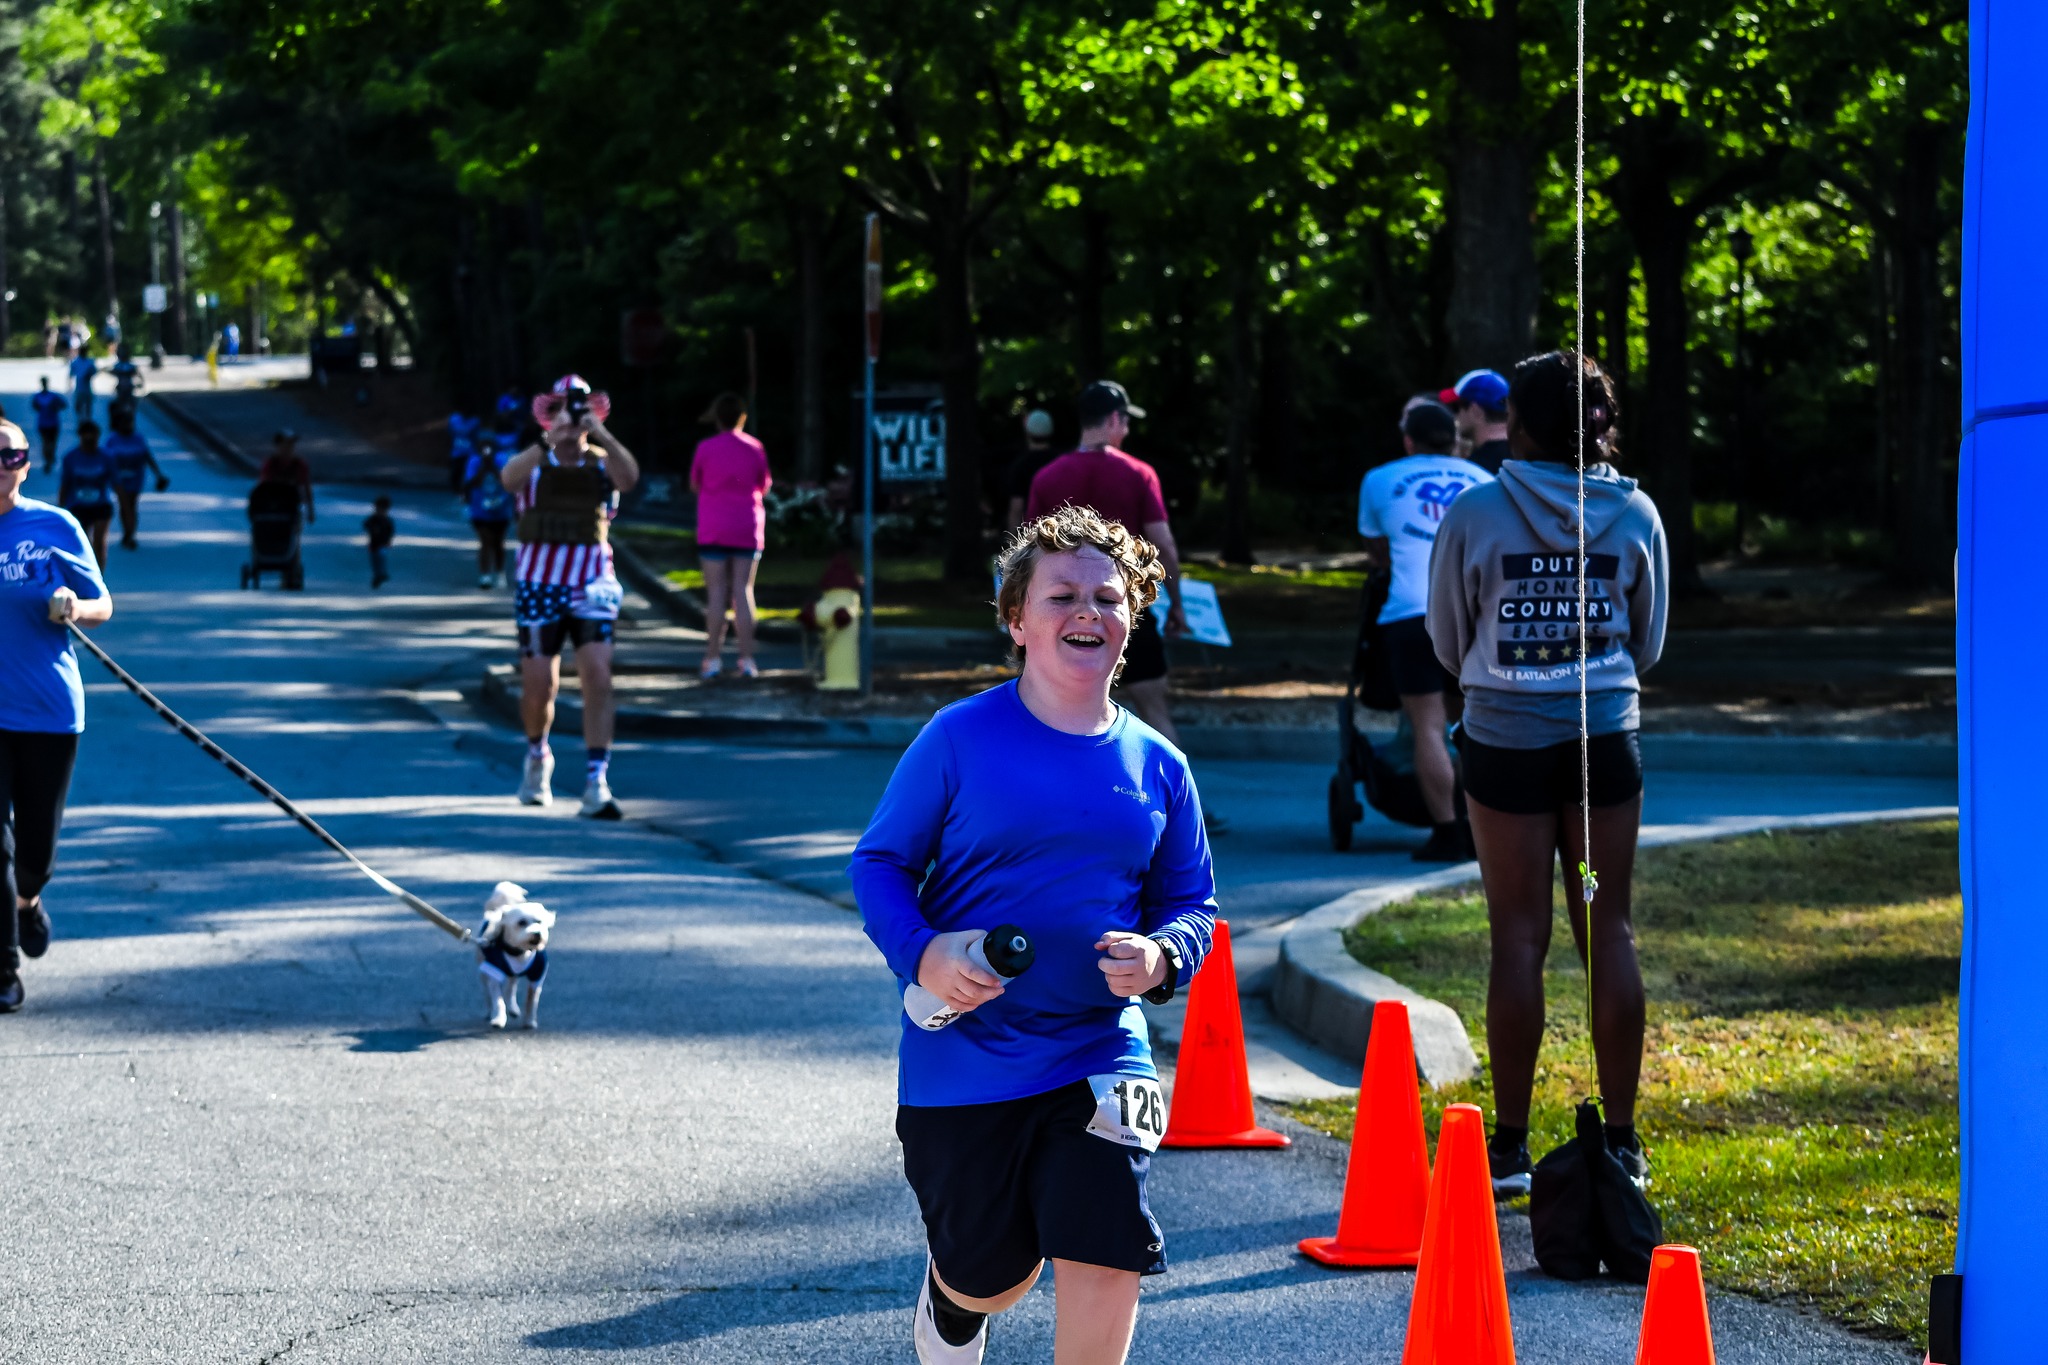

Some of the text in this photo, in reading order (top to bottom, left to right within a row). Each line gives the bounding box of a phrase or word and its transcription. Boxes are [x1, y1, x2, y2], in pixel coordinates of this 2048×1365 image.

[1517, 581, 1600, 596] HONOR
[1501, 601, 1610, 618] COUNTRY
[1512, 624, 1600, 639] EAGLS
[1515, 666, 1571, 681] BATTALION
[1574, 660, 1601, 674] AMY
[1113, 1081, 1163, 1136] 126
